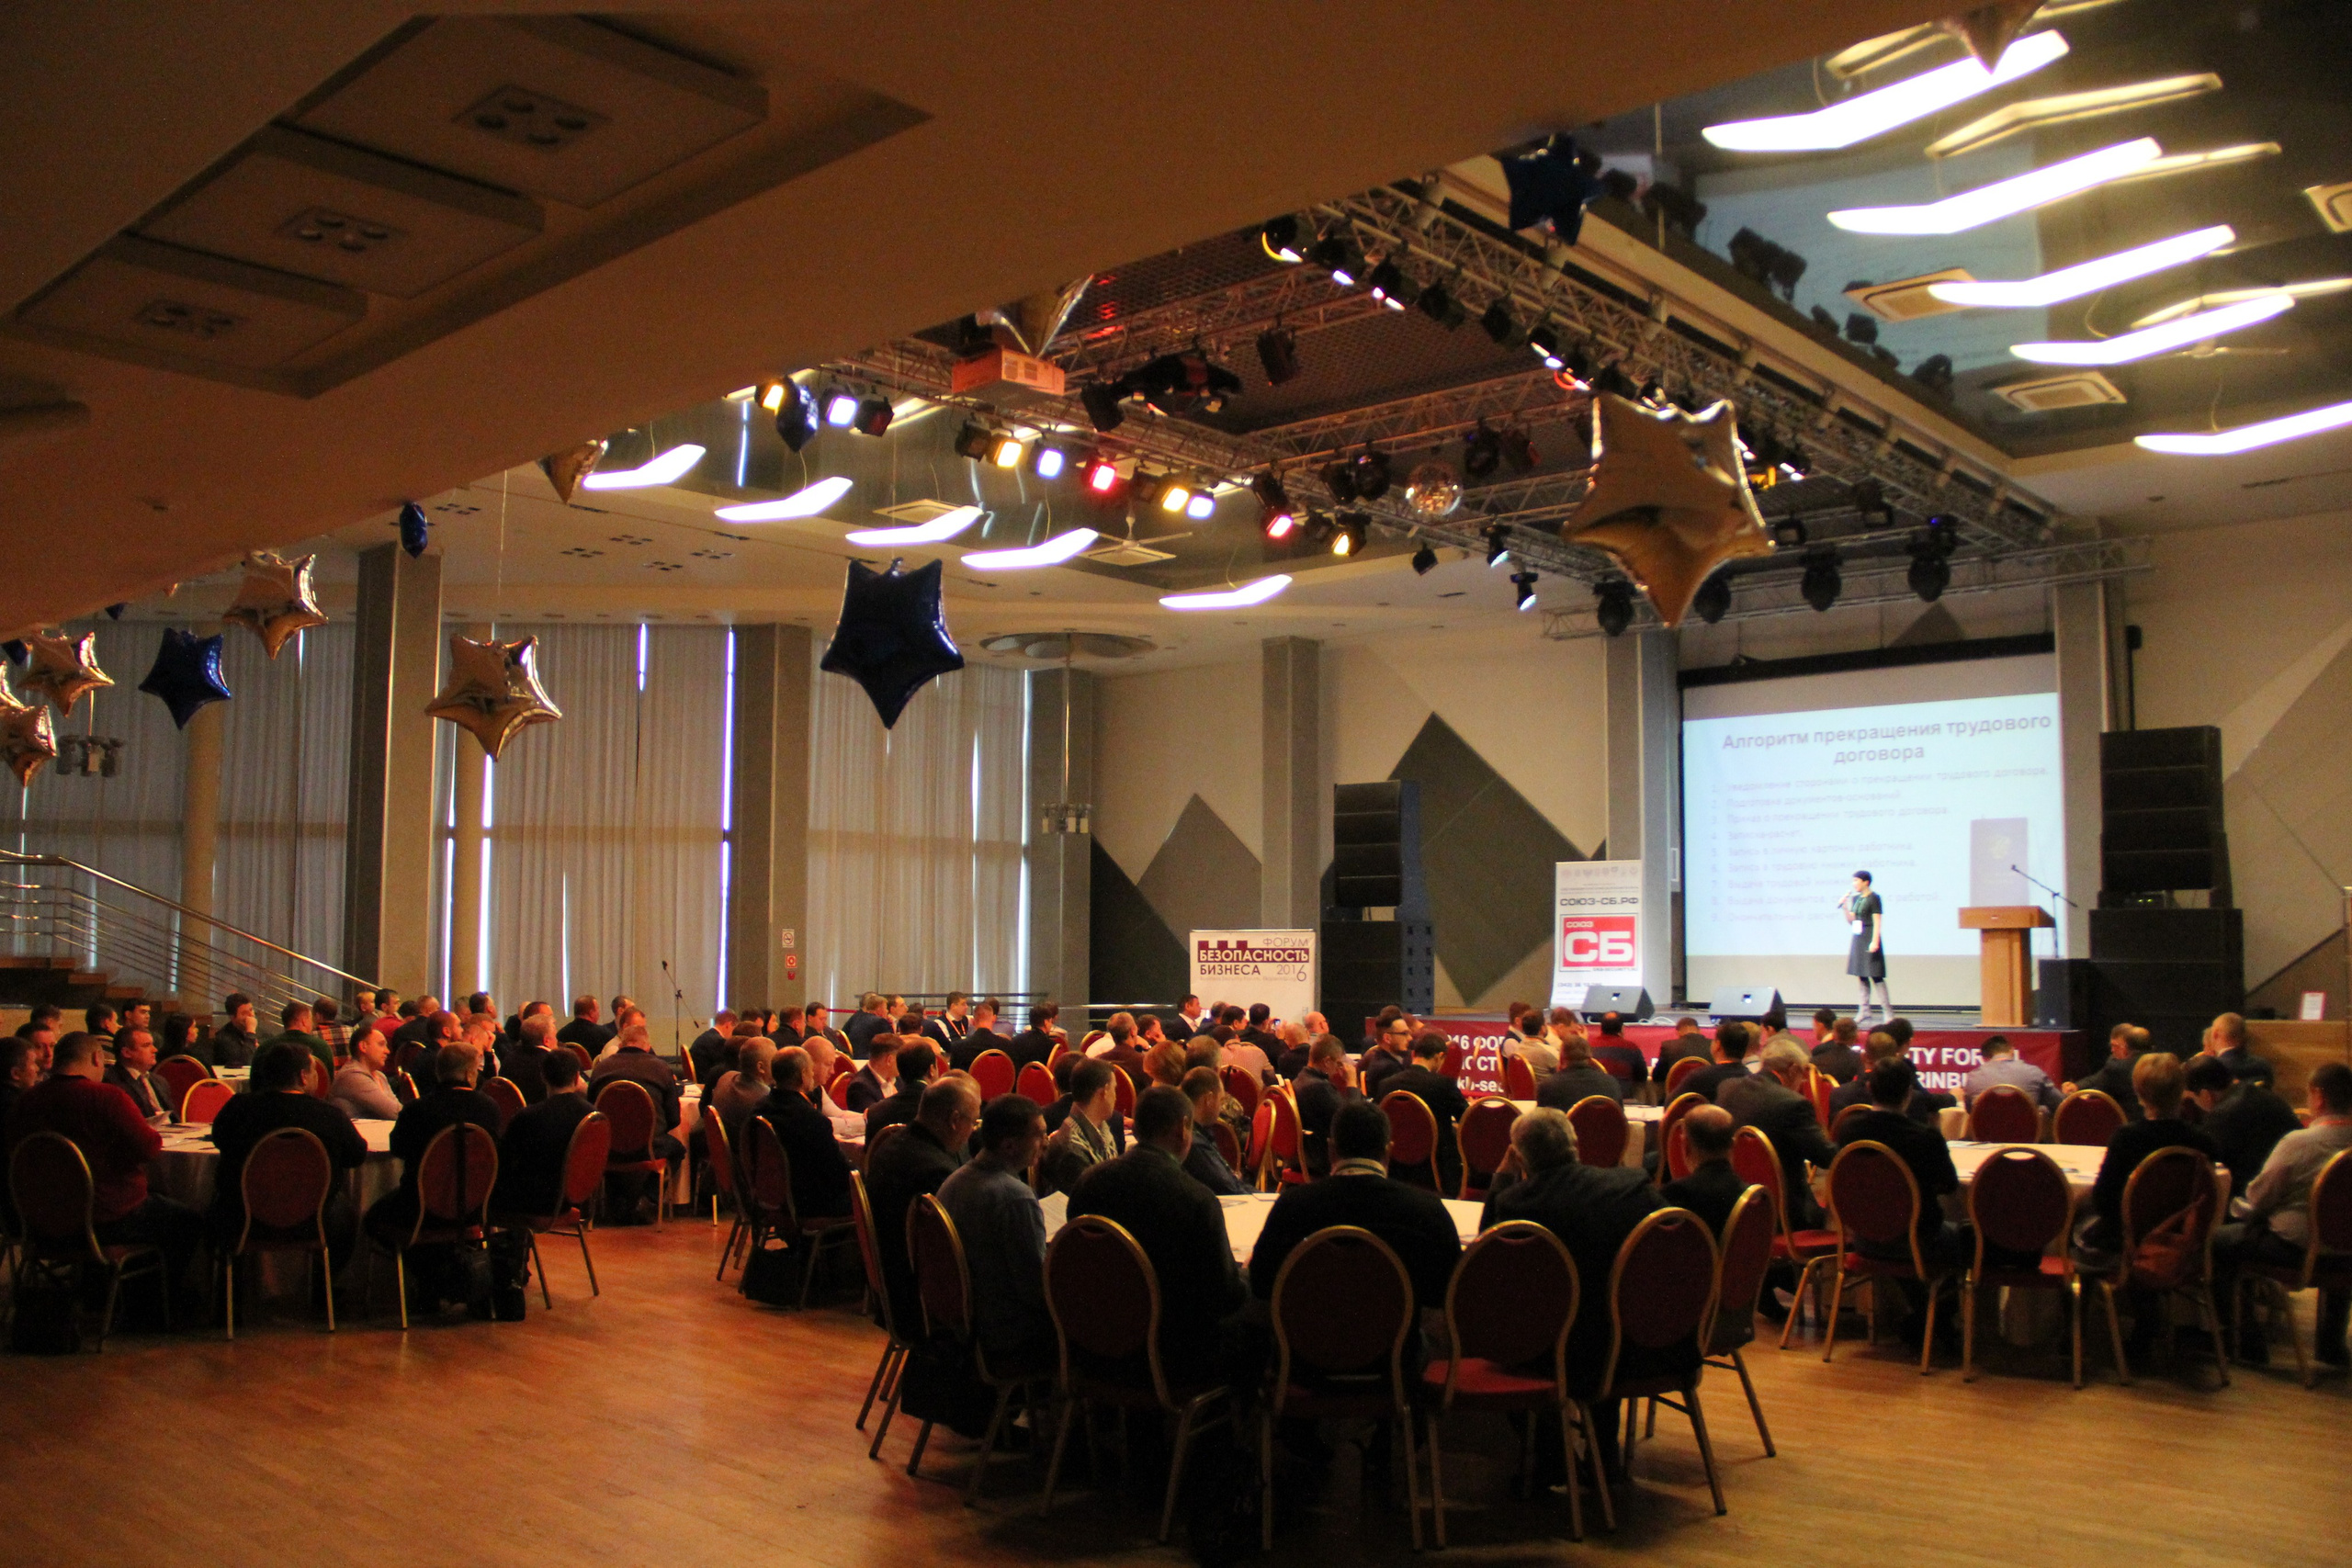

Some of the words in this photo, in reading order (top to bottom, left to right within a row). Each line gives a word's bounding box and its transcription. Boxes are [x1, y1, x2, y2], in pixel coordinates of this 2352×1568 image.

[1723, 732, 1809, 750] Алгоритм
[1814, 722, 1940, 745] прекращения
[1947, 716, 2052, 736] трудового
[1834, 746, 1925, 765] договора
[1560, 897, 1639, 907] СОЮЗ-СБ.РФ
[1263, 937, 1308, 947] ФОРУМ
[1564, 931, 1634, 963] СБ
[1199, 949, 1309, 962] БЕЗОПАСНОСТЬ
[1200, 964, 1261, 976] БИЗНЕСА
[1277, 964, 1306, 982] 2016
[1905, 1047, 1937, 1065] TY
